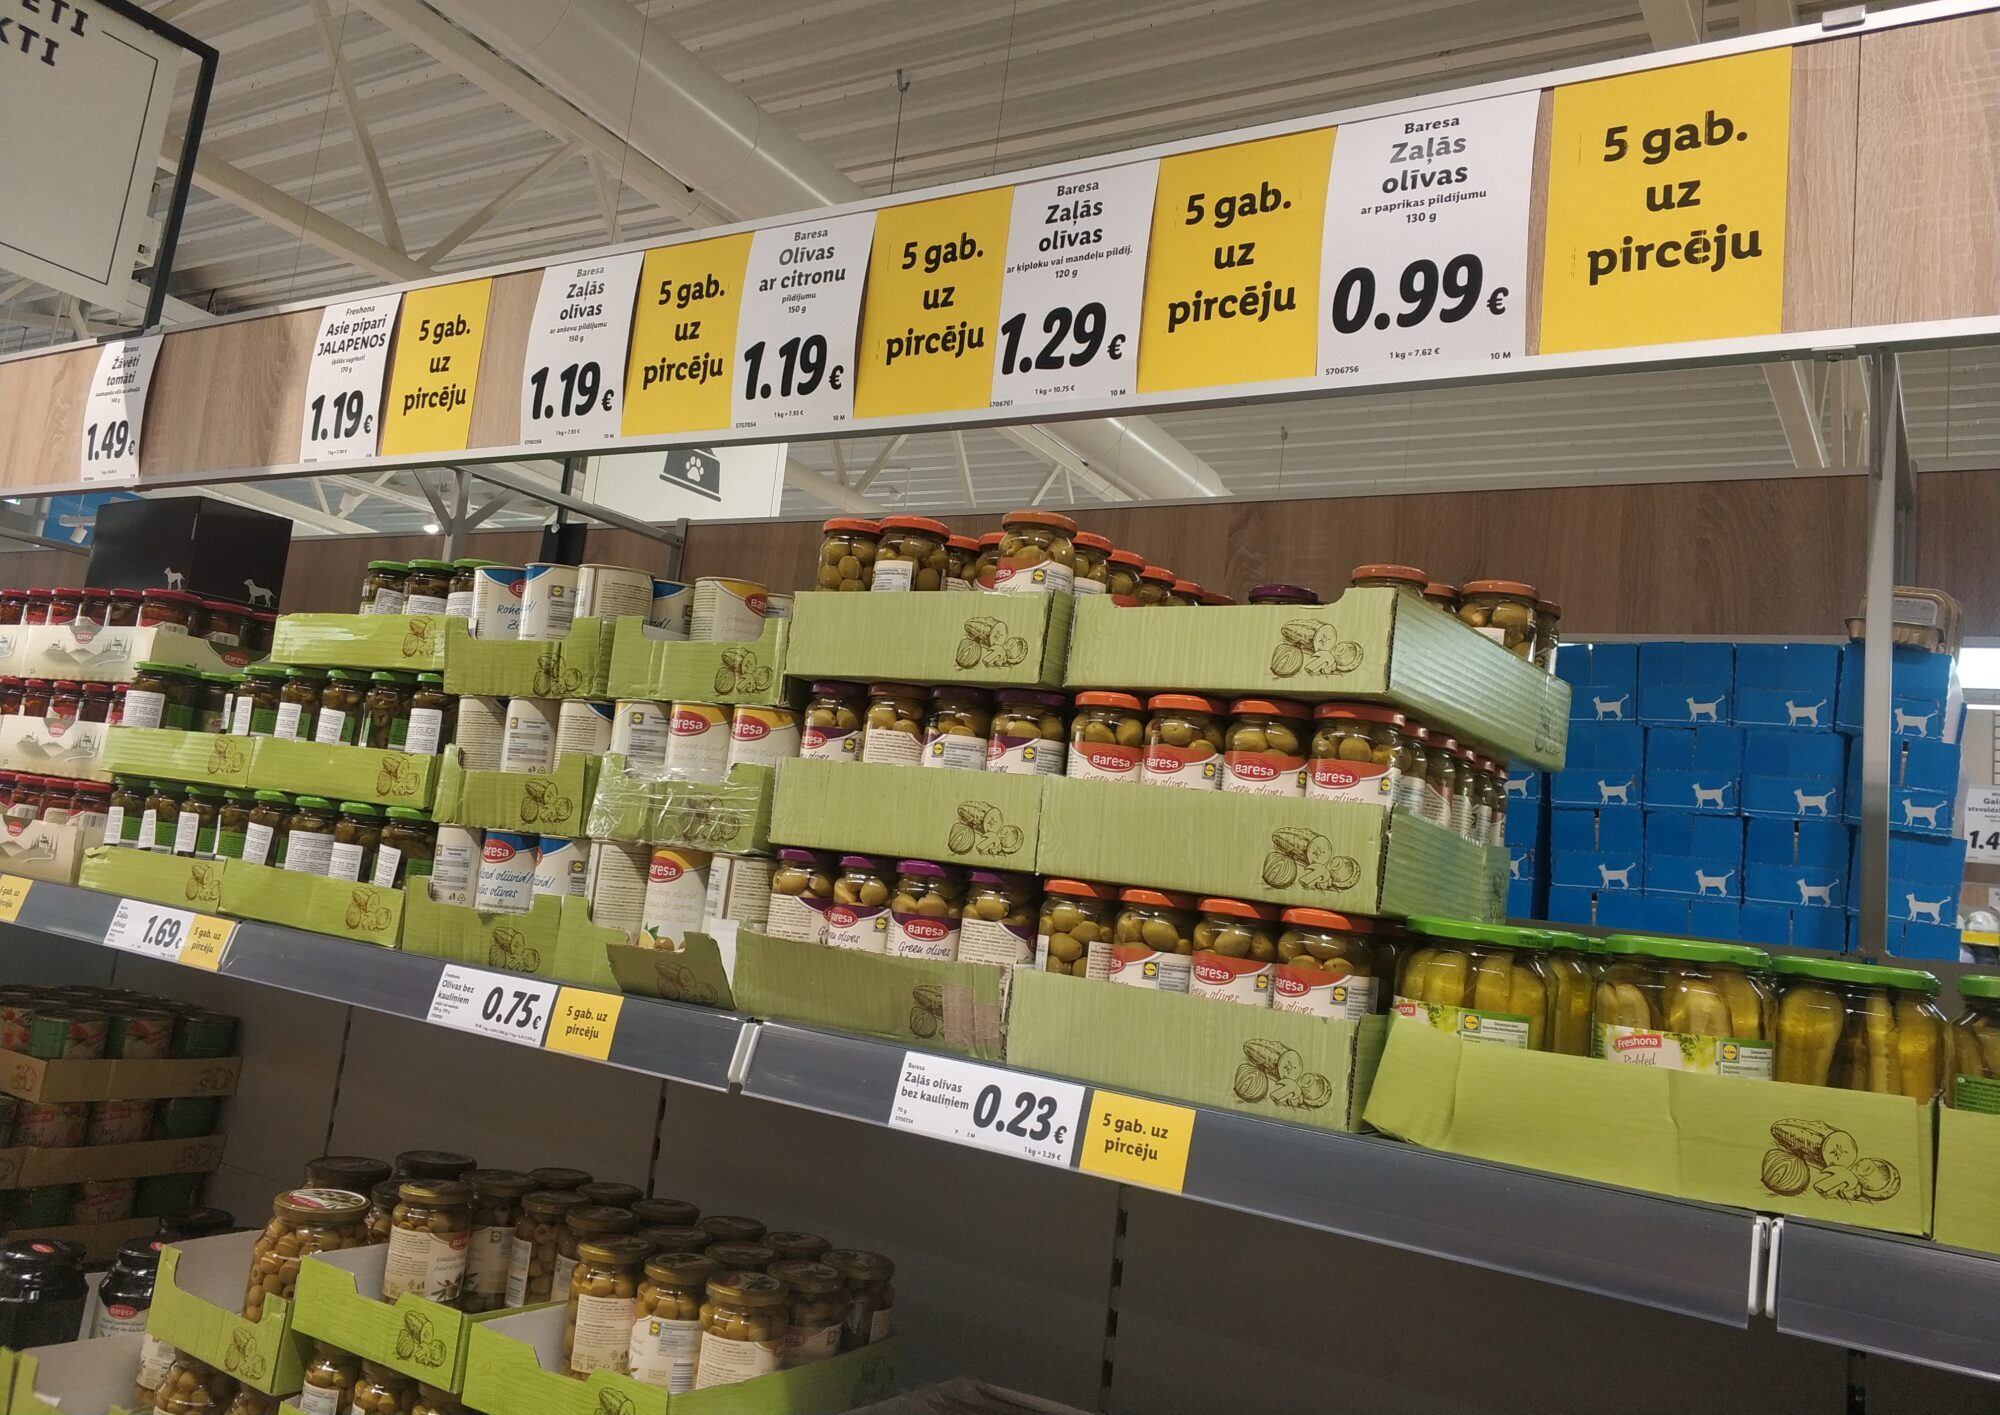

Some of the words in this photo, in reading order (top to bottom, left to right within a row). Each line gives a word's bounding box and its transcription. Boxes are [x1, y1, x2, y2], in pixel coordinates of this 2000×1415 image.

[1404, 116, 1460, 134] Baresa
[1603, 125, 1629, 162] 5
[1642, 110, 1748, 166] gab.
[1389, 136, 1467, 165] Zaļās
[1057, 181, 1100, 197] Baresa
[1381, 166, 1468, 194] olīvas
[1185, 193, 1205, 226] 5
[1213, 181, 1292, 228] gab.
[1360, 206, 1373, 215] ar
[1374, 197, 1425, 215] paprikas
[1427, 189, 1487, 207] pildījumu
[1645, 179, 1701, 213] uz
[1045, 200, 1104, 226] Zaļās
[1405, 212, 1426, 224] 130
[1428, 212, 1437, 224] g
[794, 229, 829, 242] Baresa
[1038, 227, 1103, 252] olīvas
[778, 245, 835, 266] Olīvas
[902, 241, 919, 270] 5
[923, 232, 984, 273] gab.
[1006, 265, 1016, 274] ar
[1017, 259, 1049, 274] ķiploku
[1050, 255, 1064, 266] vai
[1065, 249, 1105, 264] mandeļu
[1213, 241, 1255, 269] uz
[1587, 223, 1763, 285] pircēju
[576, 266, 605, 278] Baresa
[758, 278, 777, 292] ar
[780, 267, 846, 289] citronu
[1055, 269, 1071, 279] 120
[1071, 268, 1078, 279] g
[566, 281, 605, 302] Zaļās
[658, 280, 672, 305] 5
[676, 273, 726, 309] gab.
[781, 291, 817, 304] pildījumu
[923, 286, 955, 310] uz
[345, 305, 376, 317] Freshona
[559, 303, 603, 321] olīvas
[788, 305, 800, 314] 150
[800, 305, 807, 314] g
[1167, 280, 1296, 333] pircēju
[326, 322, 350, 337] Asie
[351, 314, 388, 336] pipari
[418, 319, 431, 341] 5
[432, 314, 471, 345] gab.
[674, 321, 701, 341] uz
[317, 332, 387, 357] JALAPENOS
[569, 334, 579, 342] 150
[886, 321, 985, 365] pircēju
[1395, 351, 1406, 360] kg
[1414, 349, 1432, 357] 7.62
[1434, 347, 1440, 355] €
[1490, 352, 1500, 360] 10
[1502, 351, 1511, 359] M
[428, 355, 451, 374] uz
[643, 352, 724, 390] pircēju
[1325, 365, 1359, 375] 5706756
[106, 370, 136, 387] tomāti
[403, 383, 467, 416] pircēju
[1039, 388, 1047, 396] kg
[1053, 385, 1070, 393] 10.75
[671, 717, 703, 730] aresa
[732, 722, 763, 735] aresa
[1092, 754, 1131, 768] Baresa
[1146, 756, 1178, 769] Baresa
[1234, 763, 1274, 776] Baresa
[1314, 770, 1353, 783] Baresa
[483, 846, 509, 857] aresa
[650, 863, 677, 876] aresa
[832, 912, 853, 923] aresa
[193, 926, 199, 936] 5
[198, 929, 212, 939] gab.
[907, 923, 944, 937] Baresa
[191, 942, 215, 954] pircēju
[1195, 964, 1230, 980] Baresa
[442, 979, 462, 991] Olīvas
[462, 983, 475, 994] bez
[566, 1005, 573, 1016] 5
[573, 1009, 594, 1021] gab.
[596, 1013, 608, 1023] uz
[565, 1022, 600, 1039] pircēju
[1617, 1035, 1658, 1049] Freshona
[904, 1071, 930, 1087] Zaļās
[932, 1078, 963, 1093] olīvas
[901, 1086, 918, 1099] bez
[920, 1090, 970, 1110] kauliņiem
[1102, 1112, 1112, 1128] 5
[1114, 1116, 1147, 1135] gab.
[1151, 1124, 1169, 1139] uz
[1028, 1147, 1036, 1157] kg
[1104, 1138, 1158, 1161] pircēju
